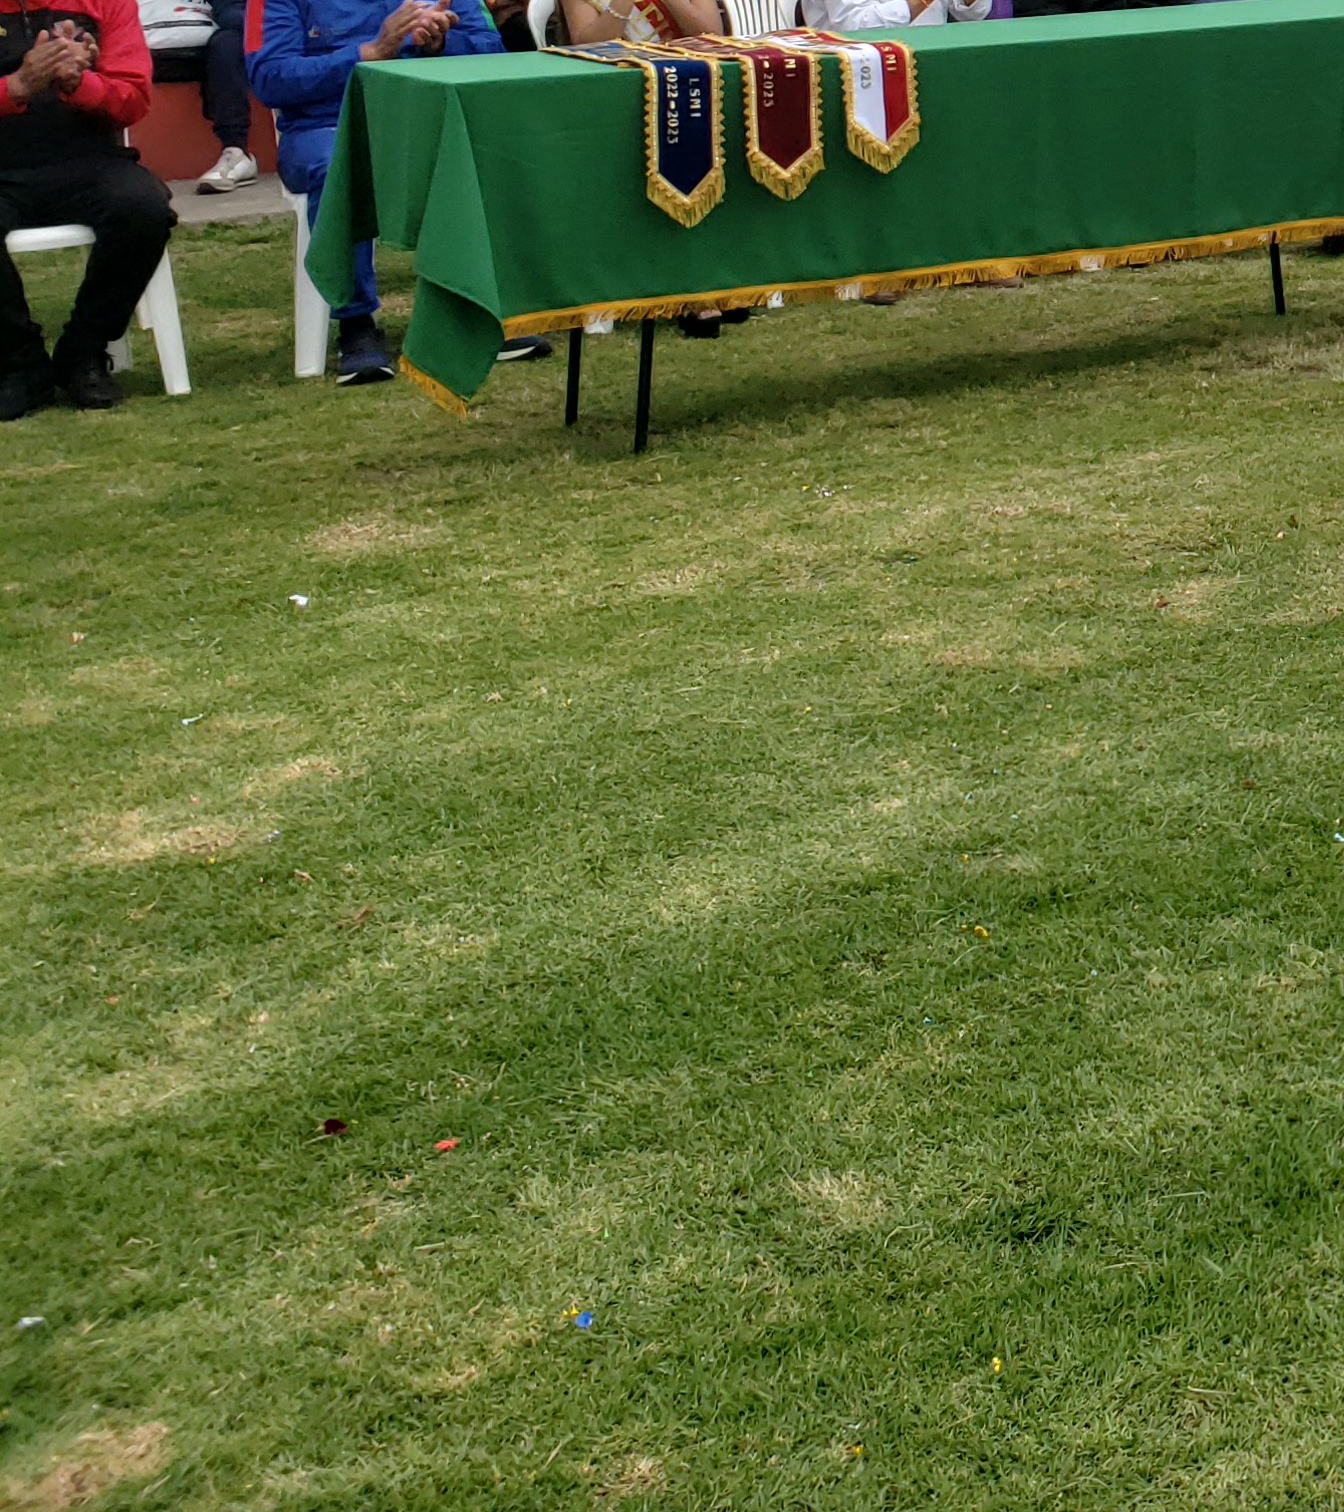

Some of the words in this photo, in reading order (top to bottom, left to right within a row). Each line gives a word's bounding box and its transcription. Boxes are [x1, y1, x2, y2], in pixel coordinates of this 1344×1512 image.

[783, 54, 797, 78] MI
[880, 45, 898, 72] SMI
[688, 77, 702, 118] LSMI
